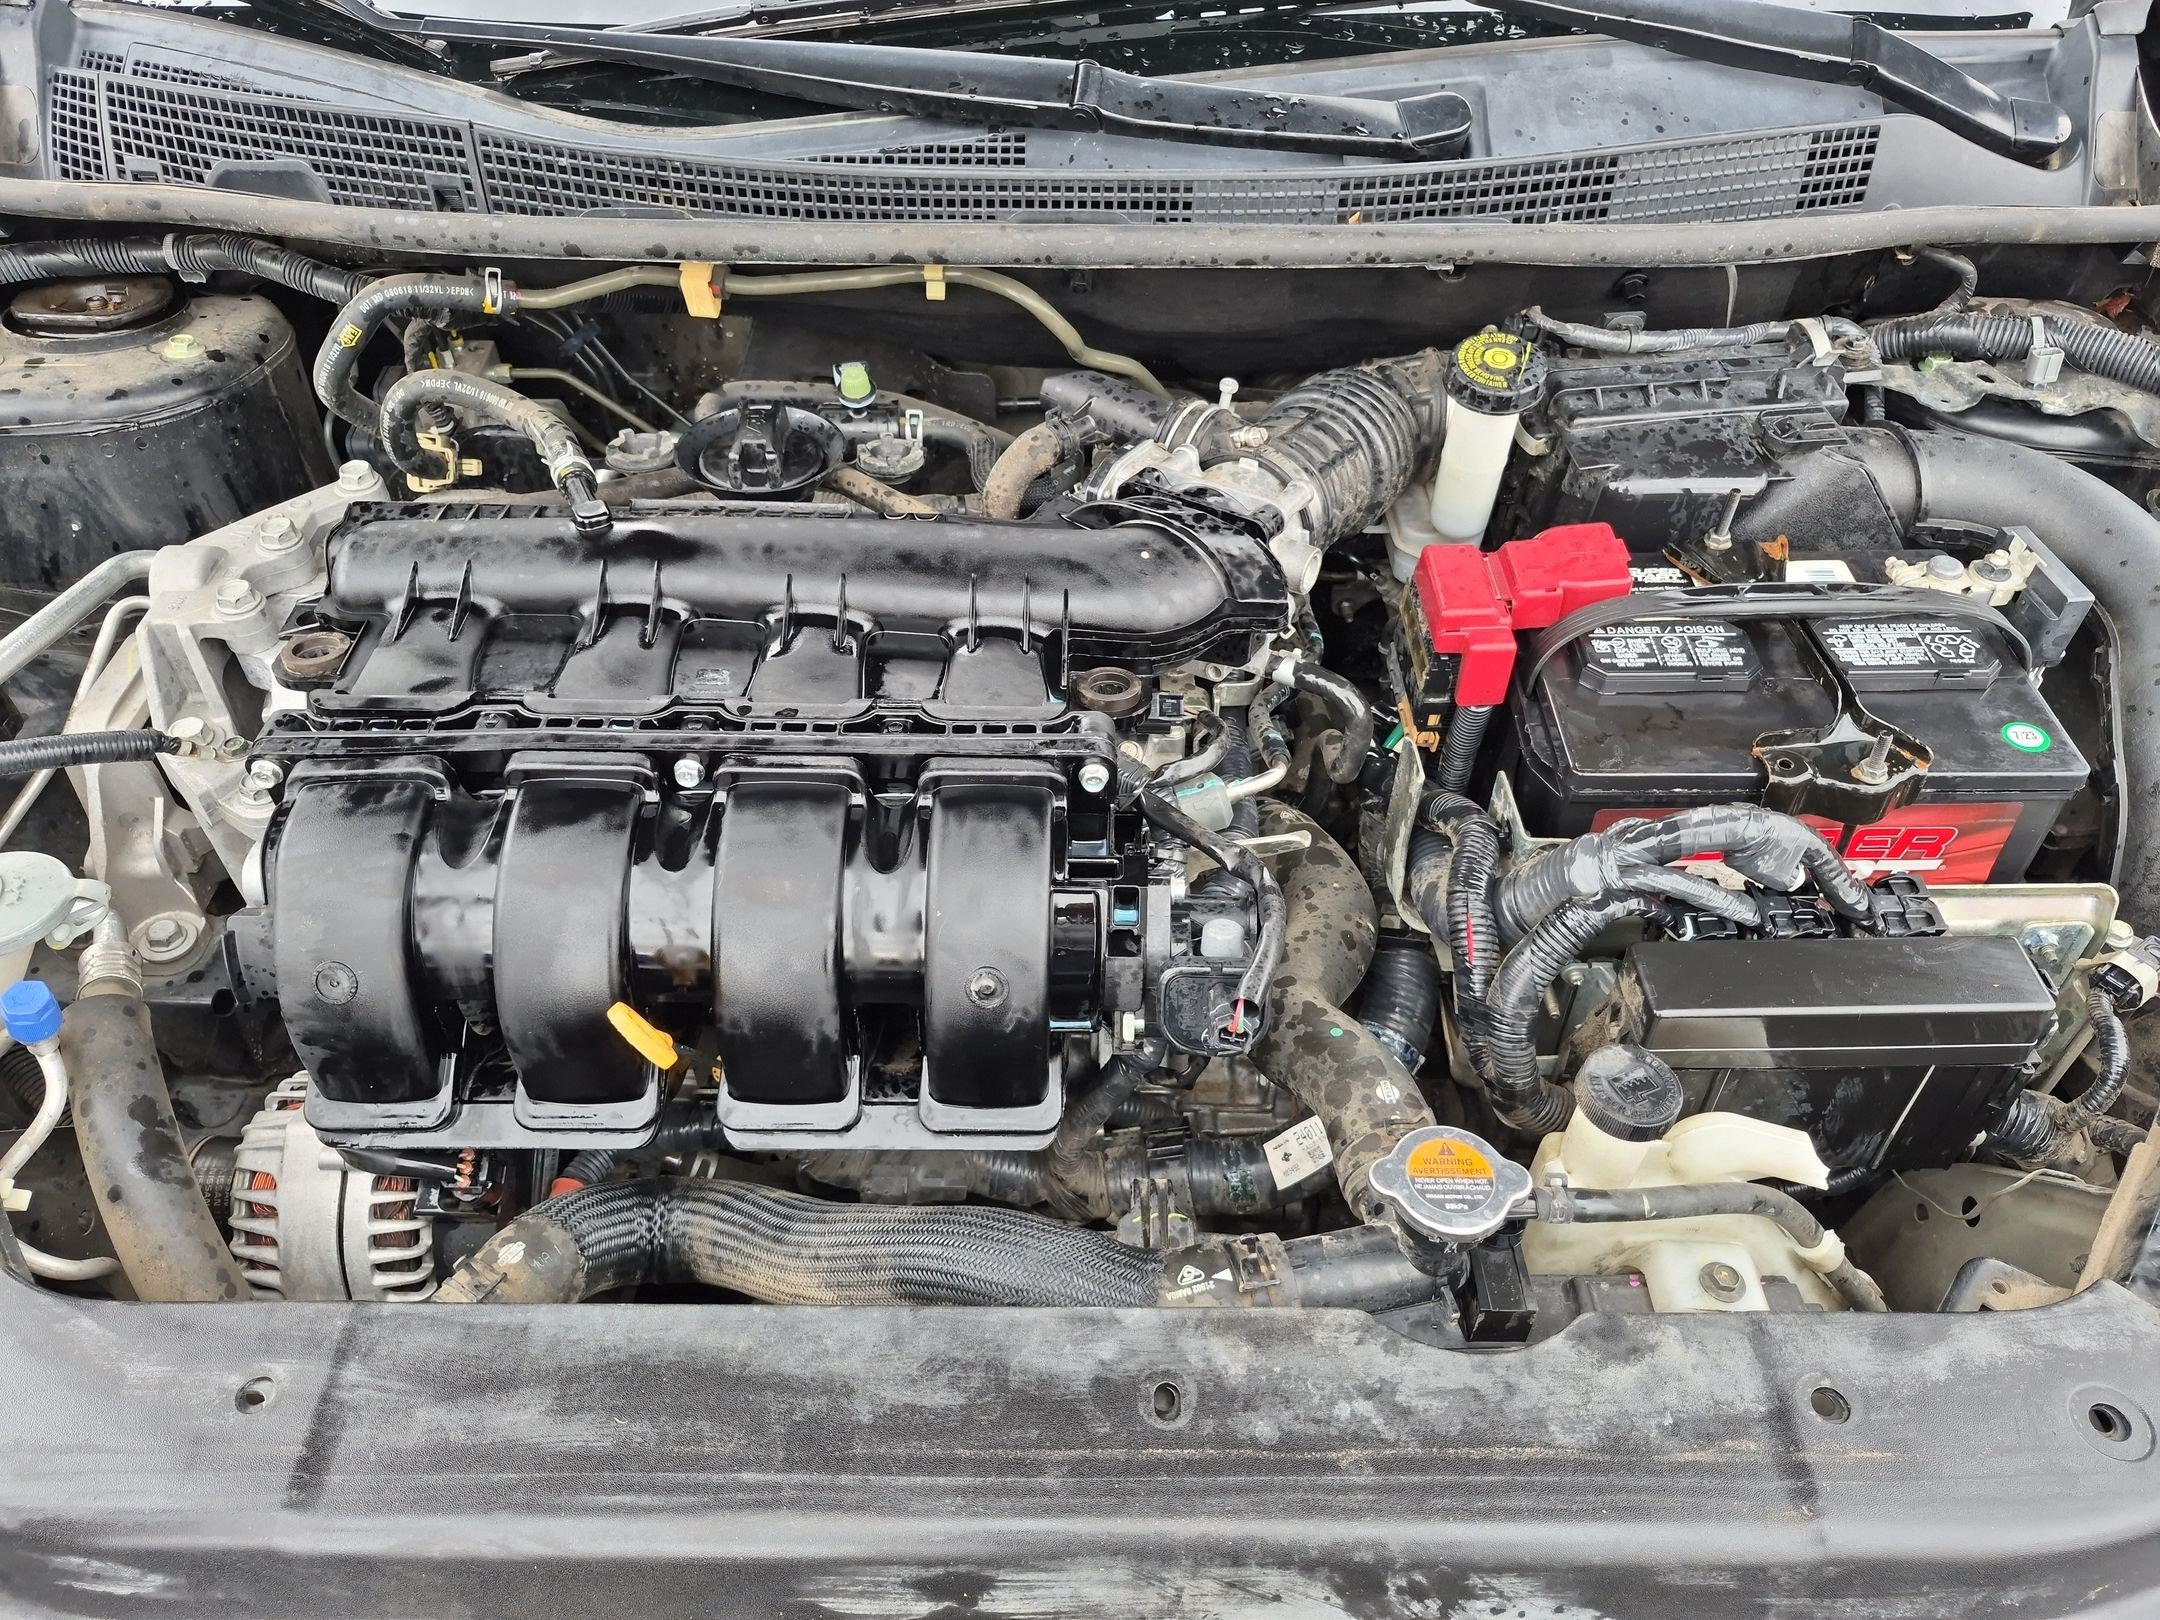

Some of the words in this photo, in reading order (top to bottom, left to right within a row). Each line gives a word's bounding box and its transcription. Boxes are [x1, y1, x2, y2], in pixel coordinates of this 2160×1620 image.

[1606, 626, 1661, 634] DANGER
[1665, 626, 1671, 634] /
[2010, 731, 2037, 740] 7/23
[1423, 1157, 1473, 1166] WARNING
[1413, 1167, 1488, 1175] AVERTISSEMENT
